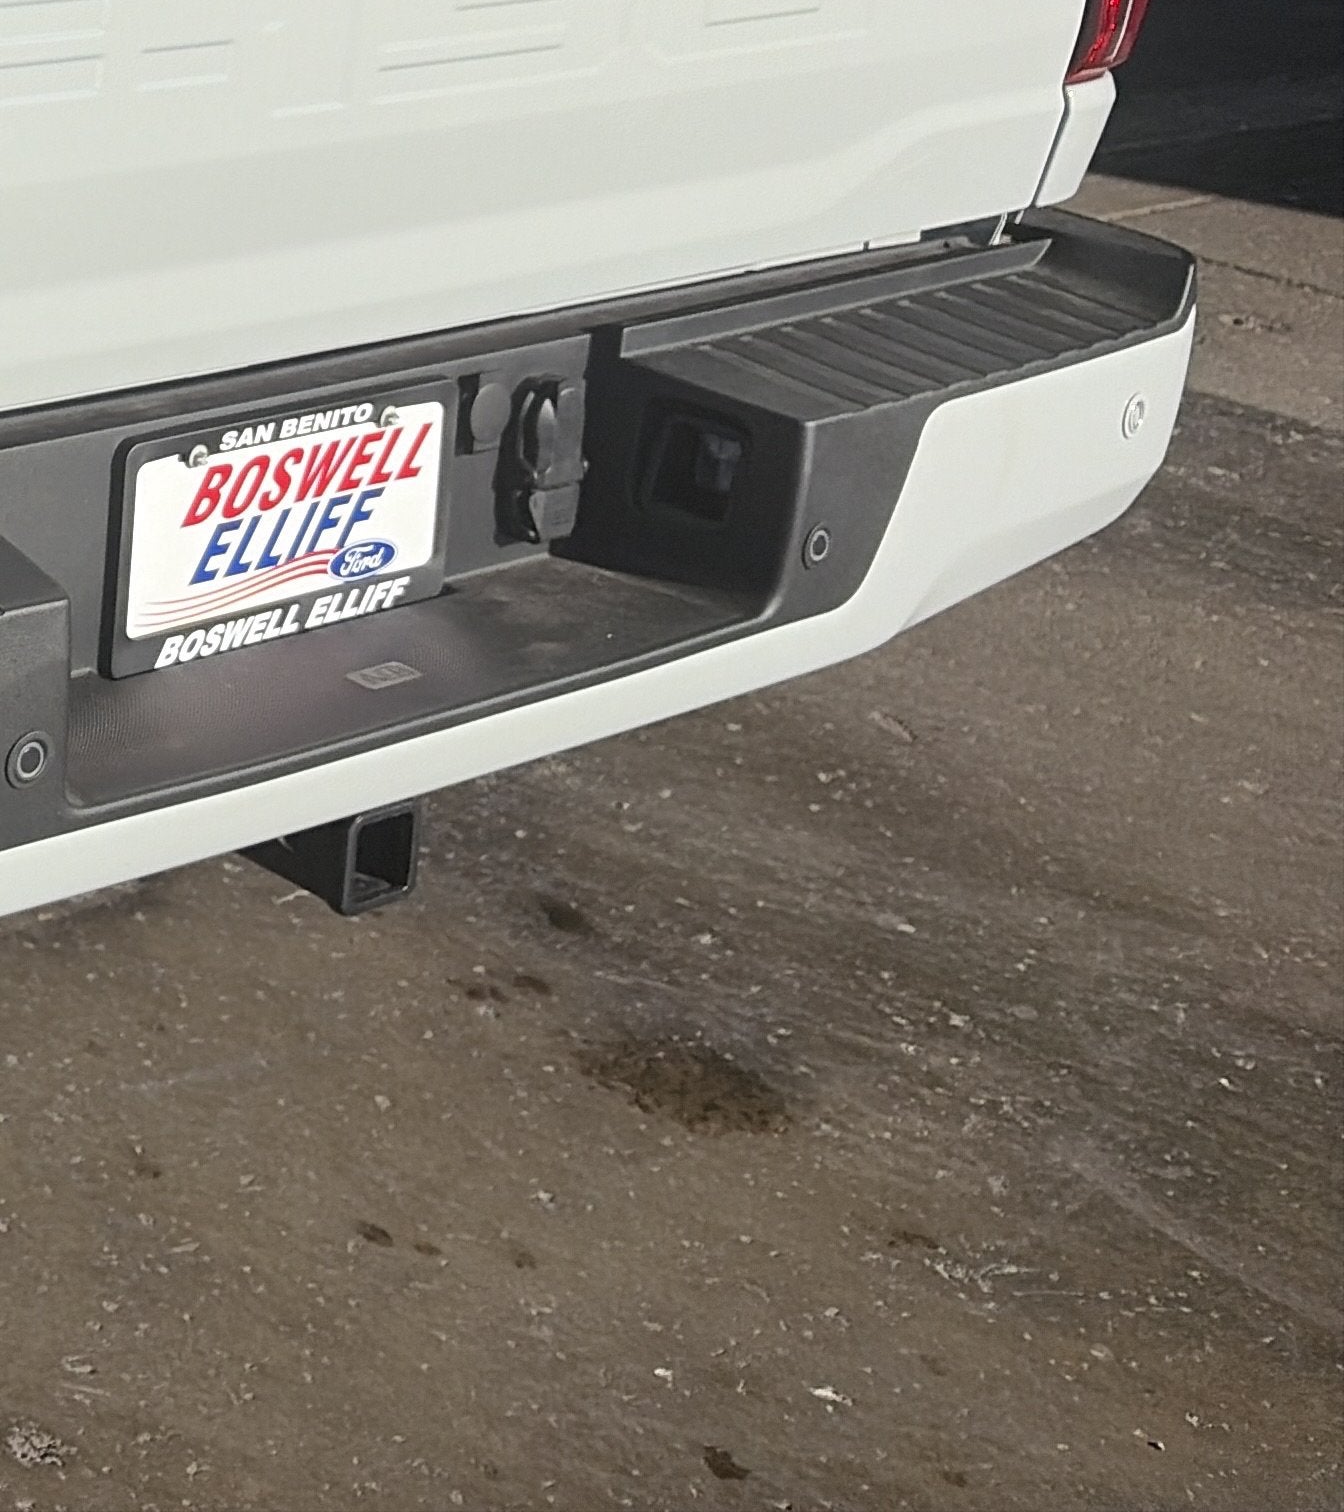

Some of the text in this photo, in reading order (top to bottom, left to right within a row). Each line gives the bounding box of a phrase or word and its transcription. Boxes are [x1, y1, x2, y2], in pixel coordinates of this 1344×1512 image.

[180, 421, 434, 528] BOSWELL
[219, 402, 375, 451] SAN BENITO
[188, 486, 387, 586] ELLIFF
[154, 576, 410, 670] BOSWELL ELLIFF
